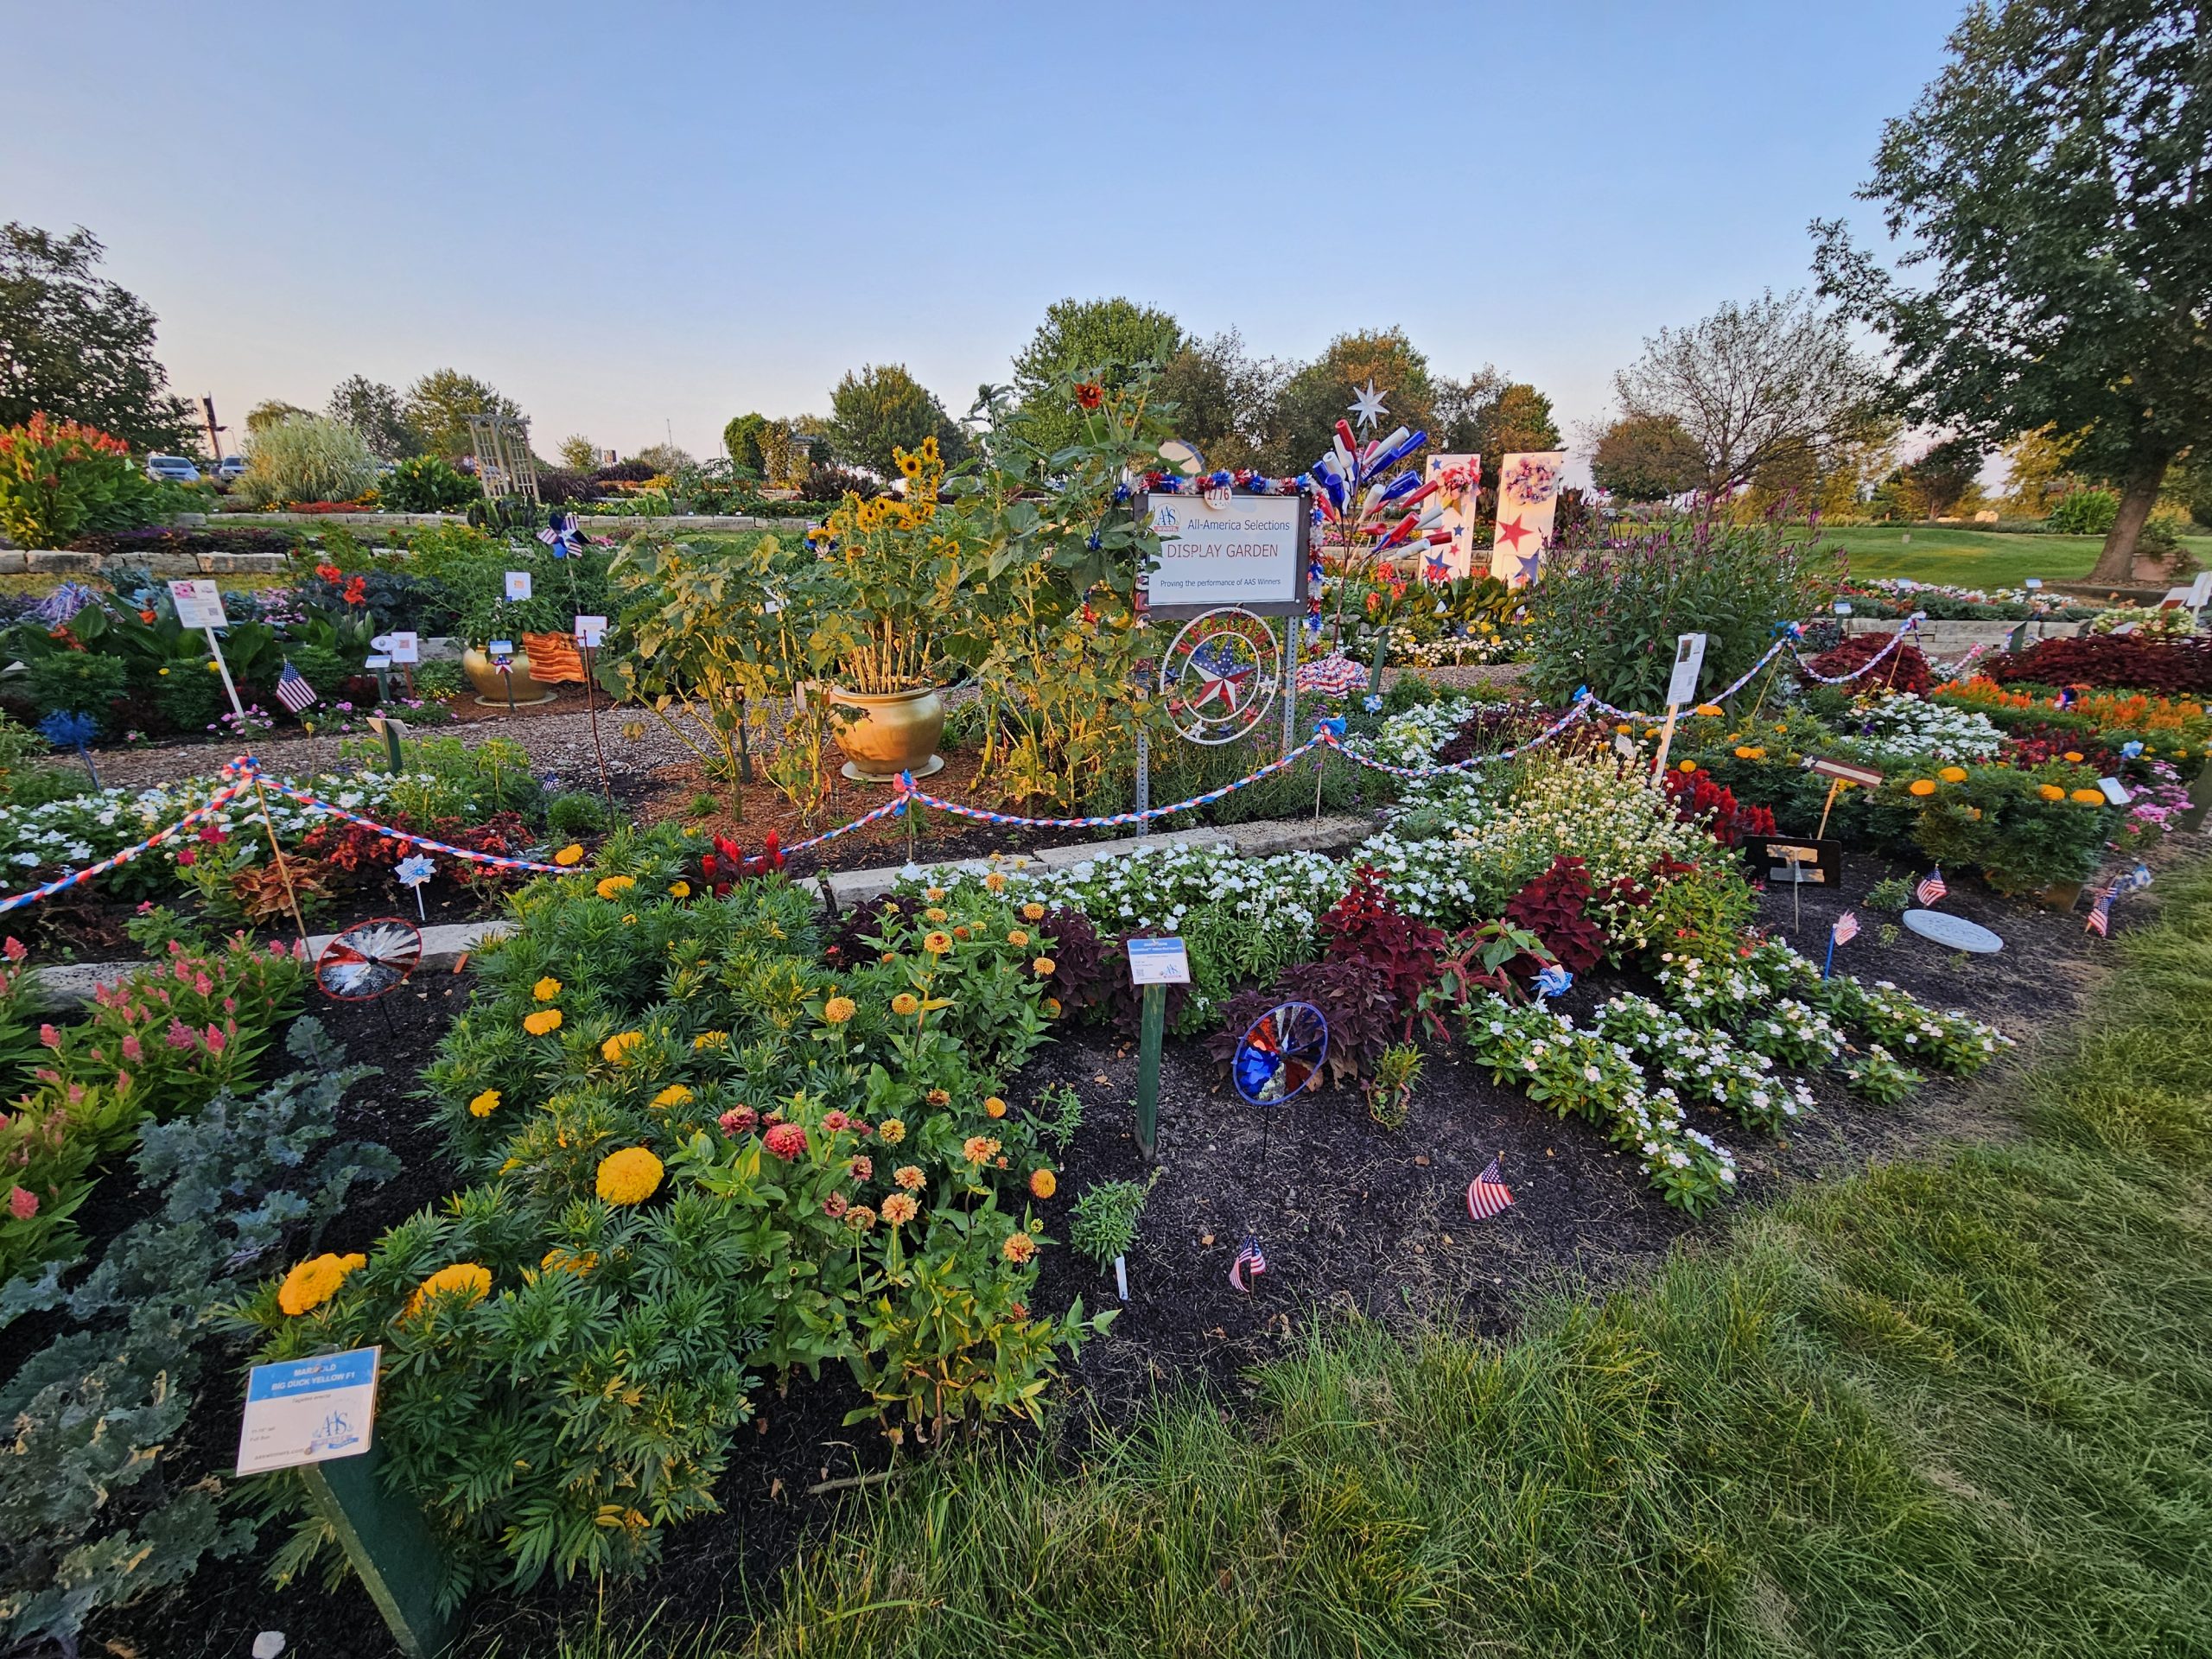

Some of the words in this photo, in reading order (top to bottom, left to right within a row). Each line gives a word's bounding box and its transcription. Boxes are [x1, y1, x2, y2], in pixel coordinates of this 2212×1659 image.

[1207, 487, 1230, 500] 1776
[1158, 505, 1176, 525] AAS
[1187, 519, 1242, 531] All-America
[1244, 519, 1290, 531] Selections
[1167, 543, 1223, 558] DISPLAY
[1226, 543, 1278, 558] GARDEN
[1160, 580, 1184, 588] Proving
[1197, 579, 1236, 588] performance
[1175, 612, 1278, 663] WELCOME
[294, 1363, 337, 1376] MAROLD
[271, 1382, 286, 1391] BIG
[287, 1378, 310, 1388] DUCK
[312, 1373, 345, 1384] YELLOW
[346, 1371, 355, 1380] F1
